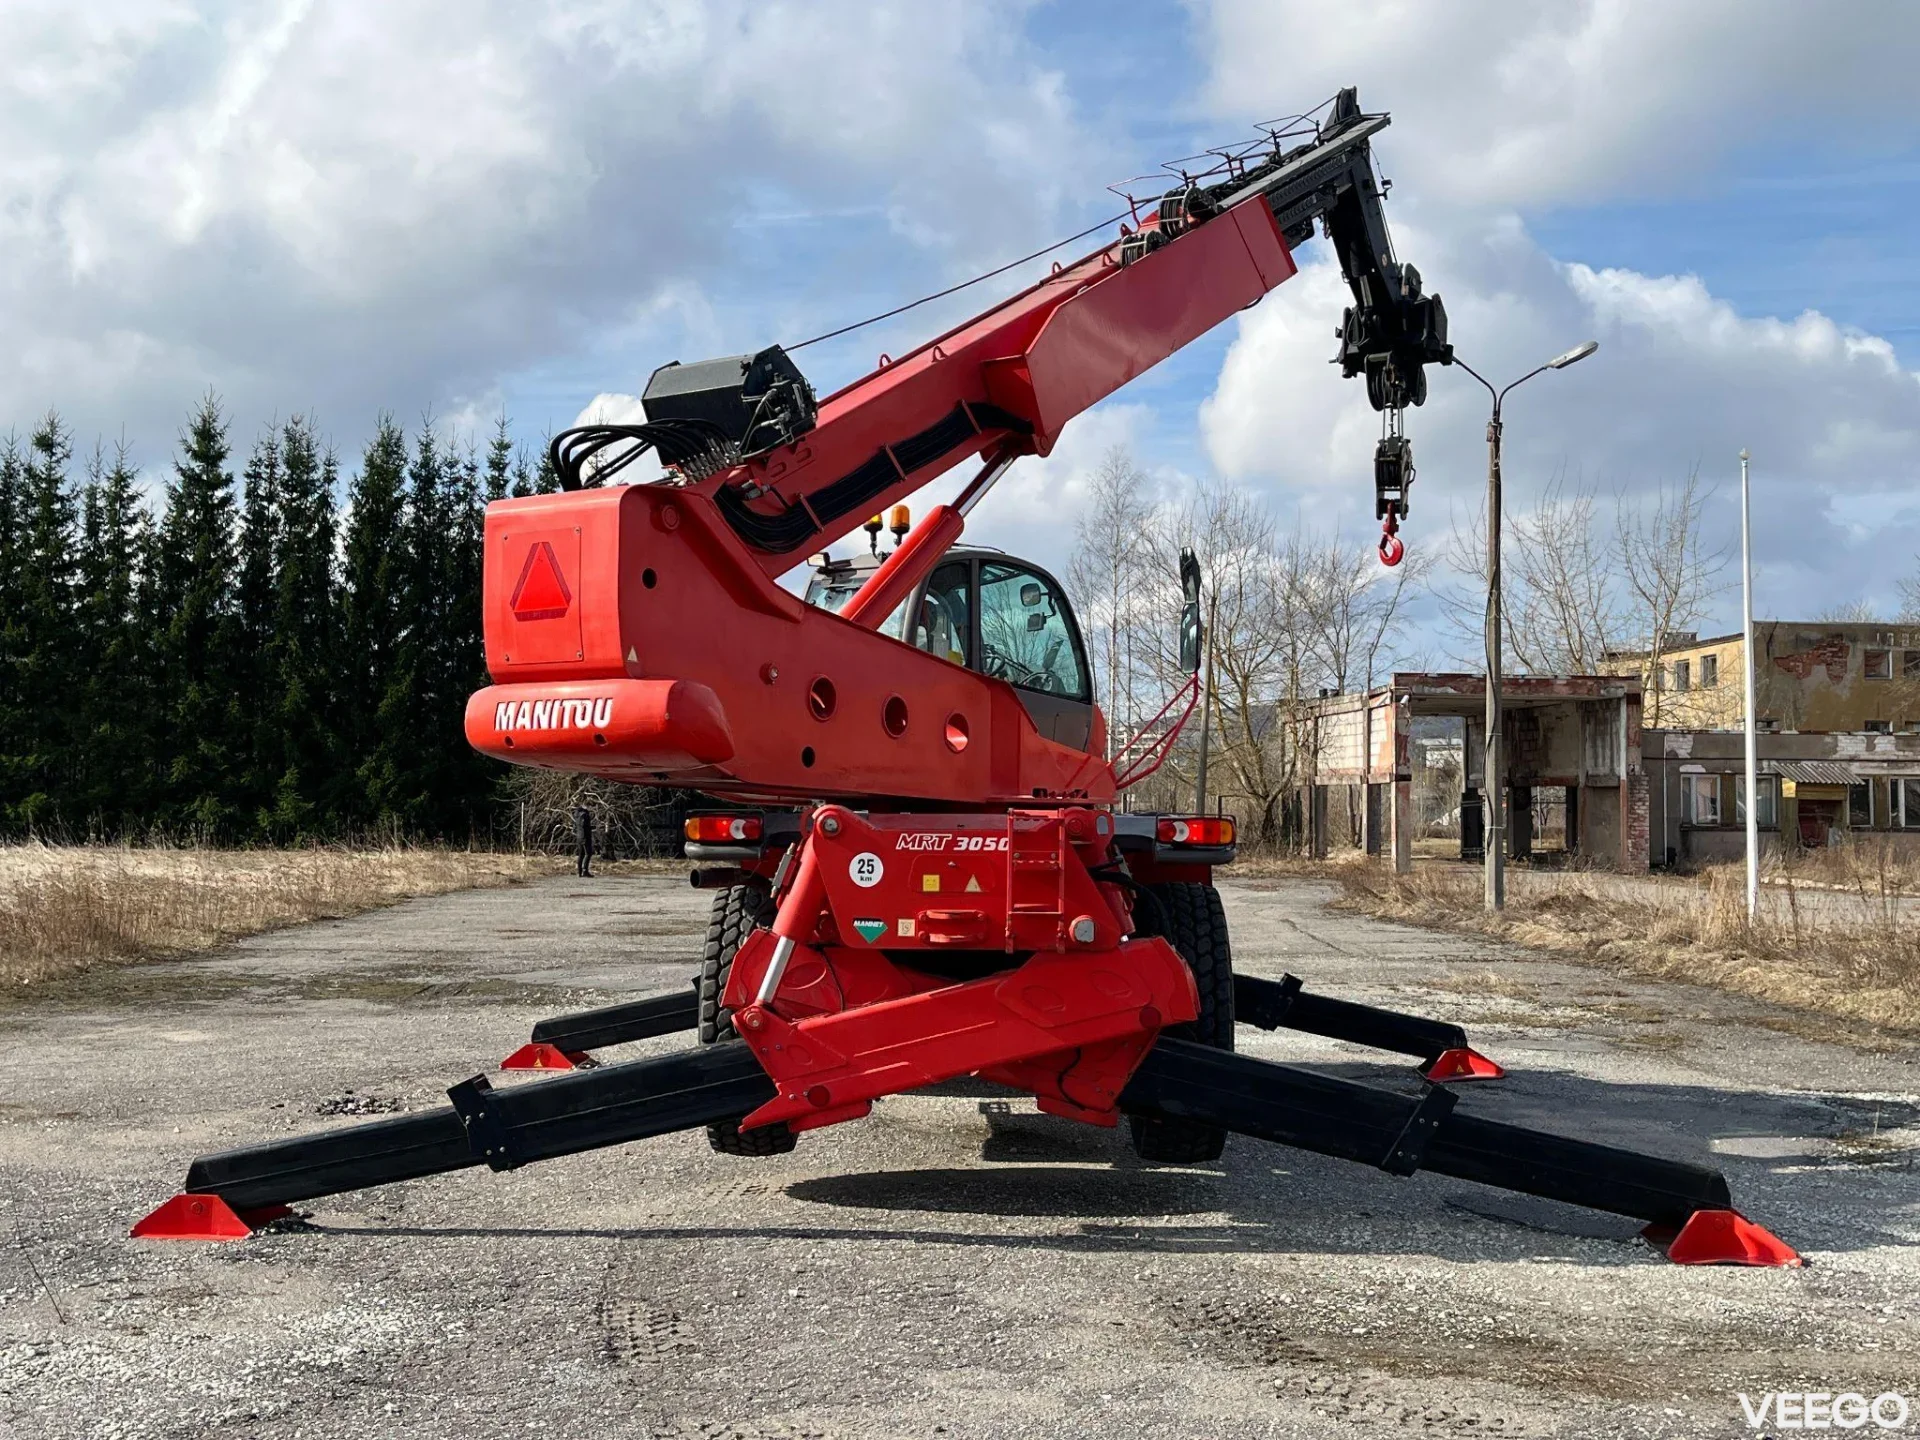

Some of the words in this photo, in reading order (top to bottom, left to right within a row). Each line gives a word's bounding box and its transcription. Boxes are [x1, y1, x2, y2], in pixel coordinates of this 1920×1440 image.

[494, 697, 613, 731] MANITOU
[895, 833, 953, 851] MRT
[857, 858, 875, 875] 25
